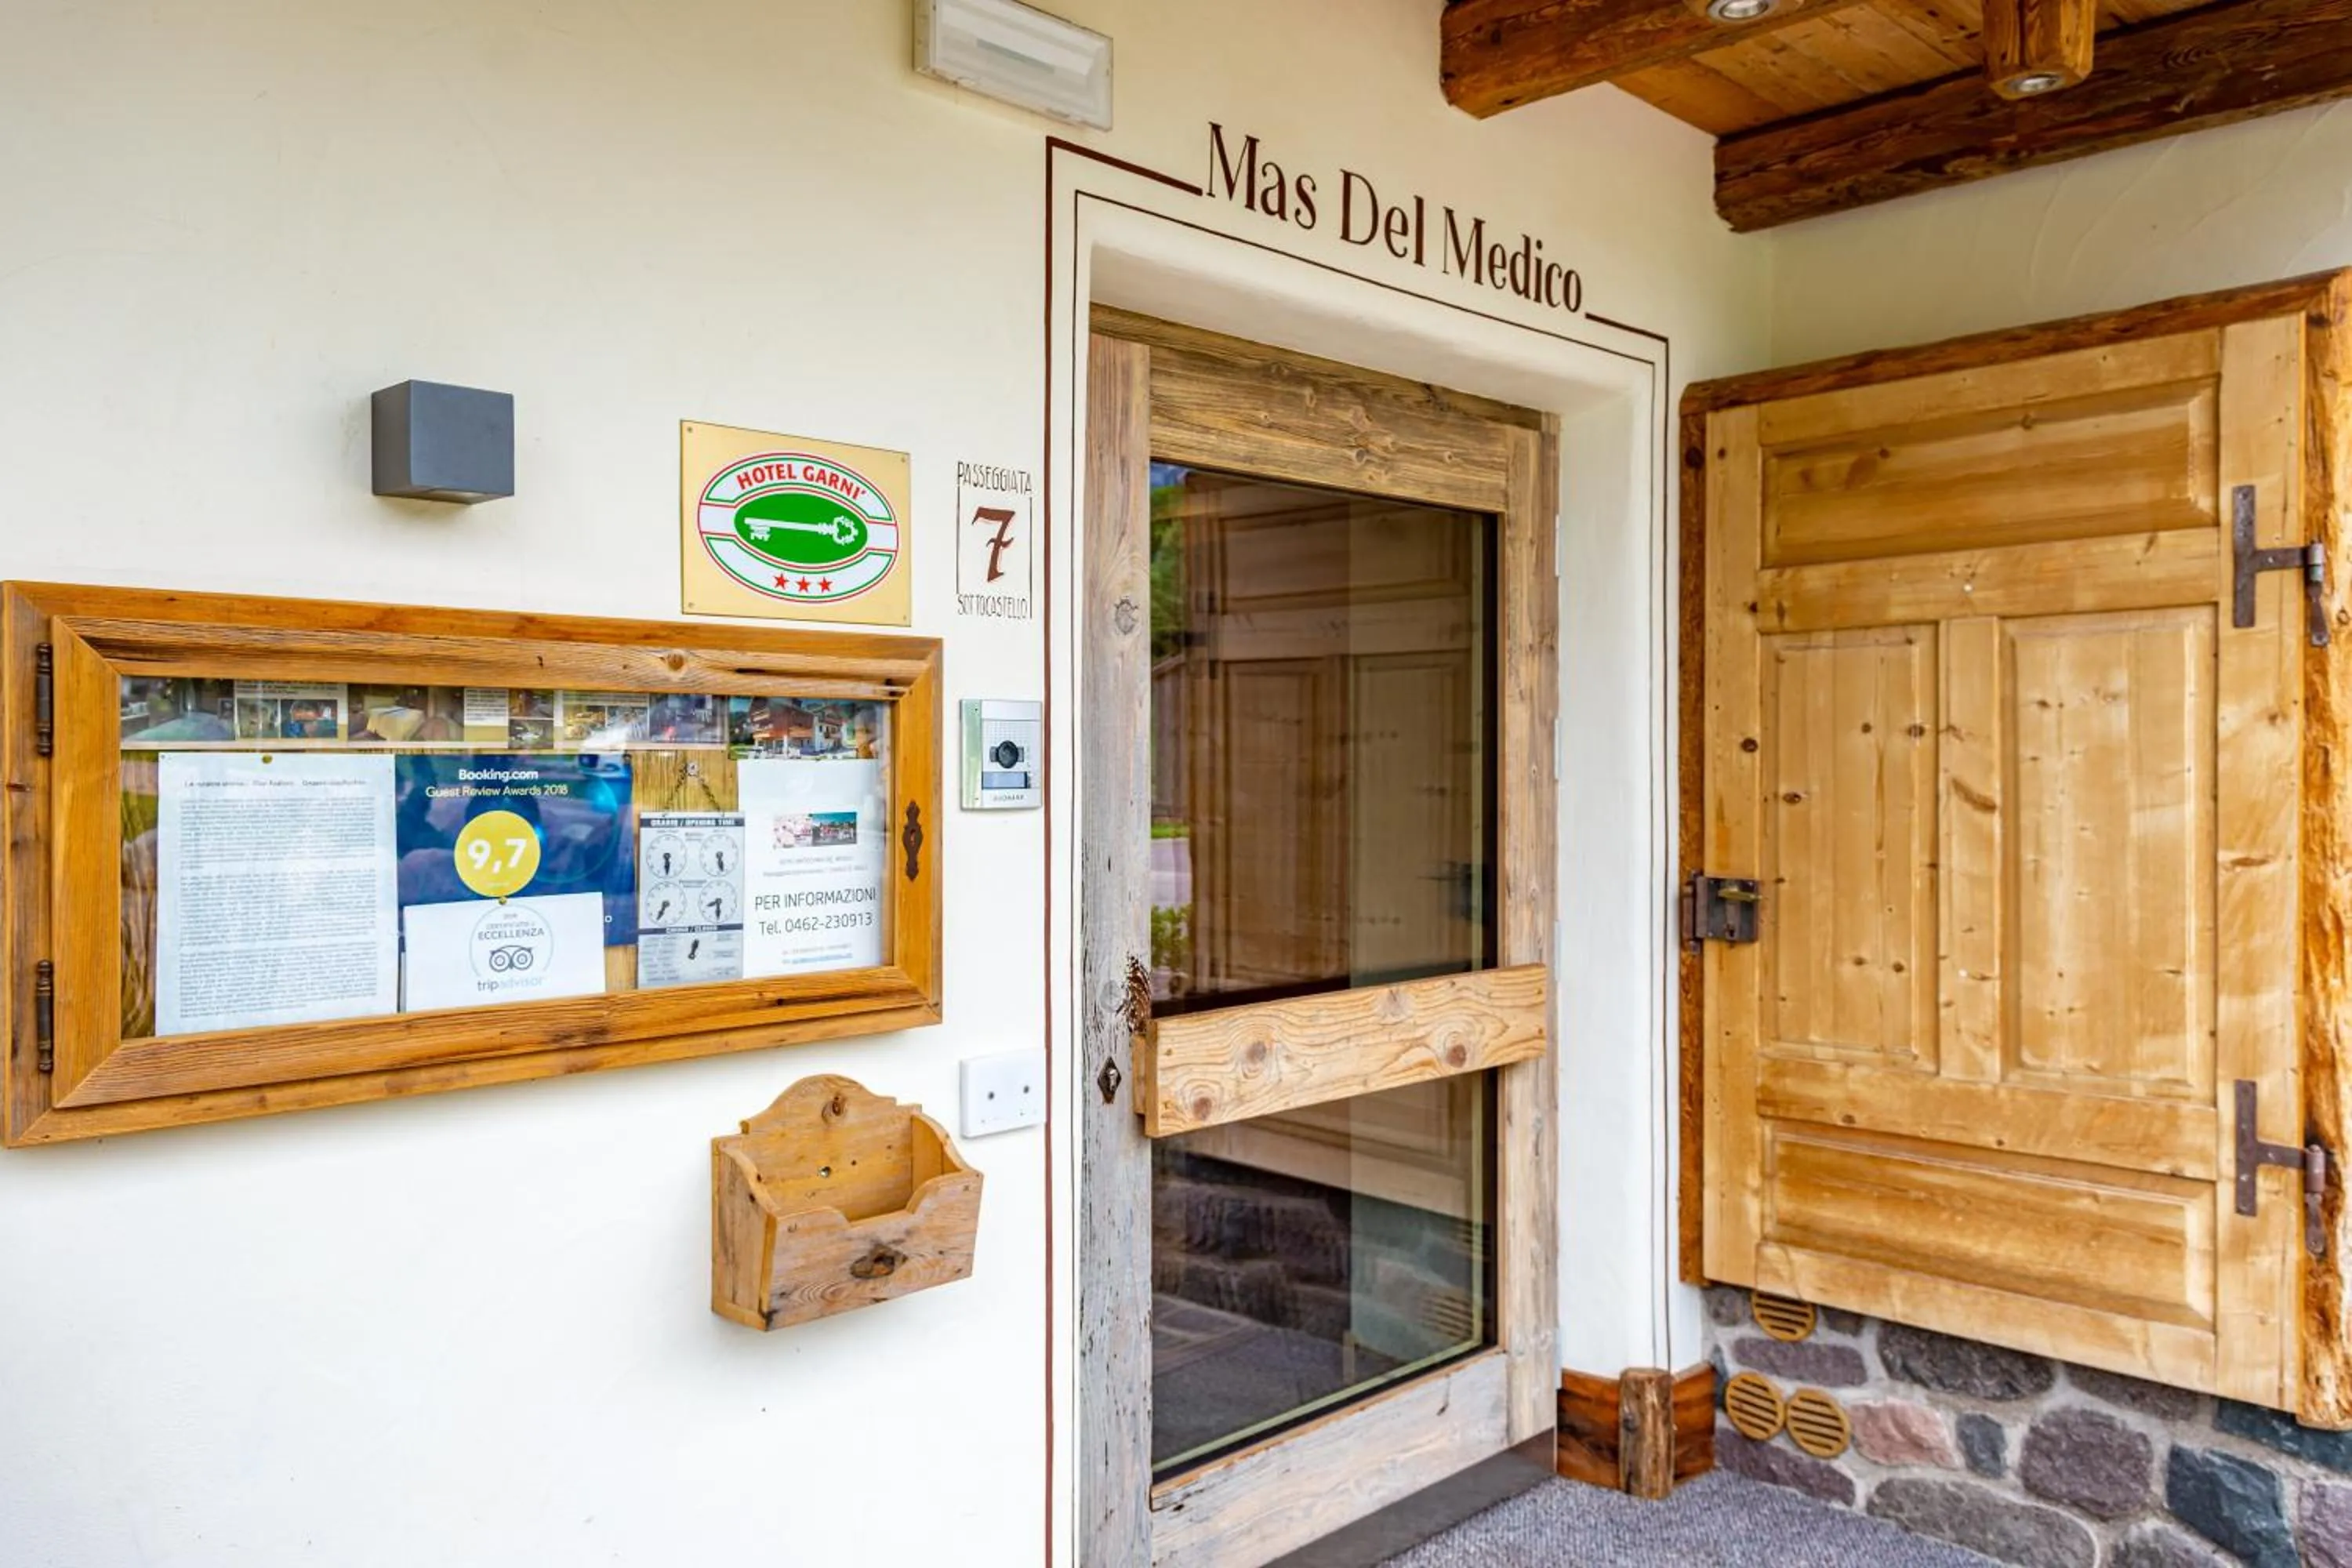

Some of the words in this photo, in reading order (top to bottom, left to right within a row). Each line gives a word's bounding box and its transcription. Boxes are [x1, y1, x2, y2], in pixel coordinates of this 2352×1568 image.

[1206, 121, 1317, 230] Mas
[1339, 169, 1426, 267] Del
[1442, 206, 1583, 314] Medico
[736, 463, 797, 490] HOTEL
[957, 460, 1033, 496] PASSEGGIATA
[971, 506, 1016, 583] 7
[957, 593, 1028, 620] SOTTOCASTELLO
[459, 768, 539, 782] Booking.com
[426, 786, 461, 798] Guest
[463, 786, 501, 797] Review
[503, 785, 542, 797] Awards
[467, 838, 527, 875] 9,7
[755, 894, 781, 911] PER
[785, 887, 877, 908] INFORMAZIONI
[477, 927, 545, 941] ECCELLENZA
[759, 920, 782, 936] Tel.
[785, 912, 873, 933] 0462-230913
[477, 976, 546, 993] tripadvisor
